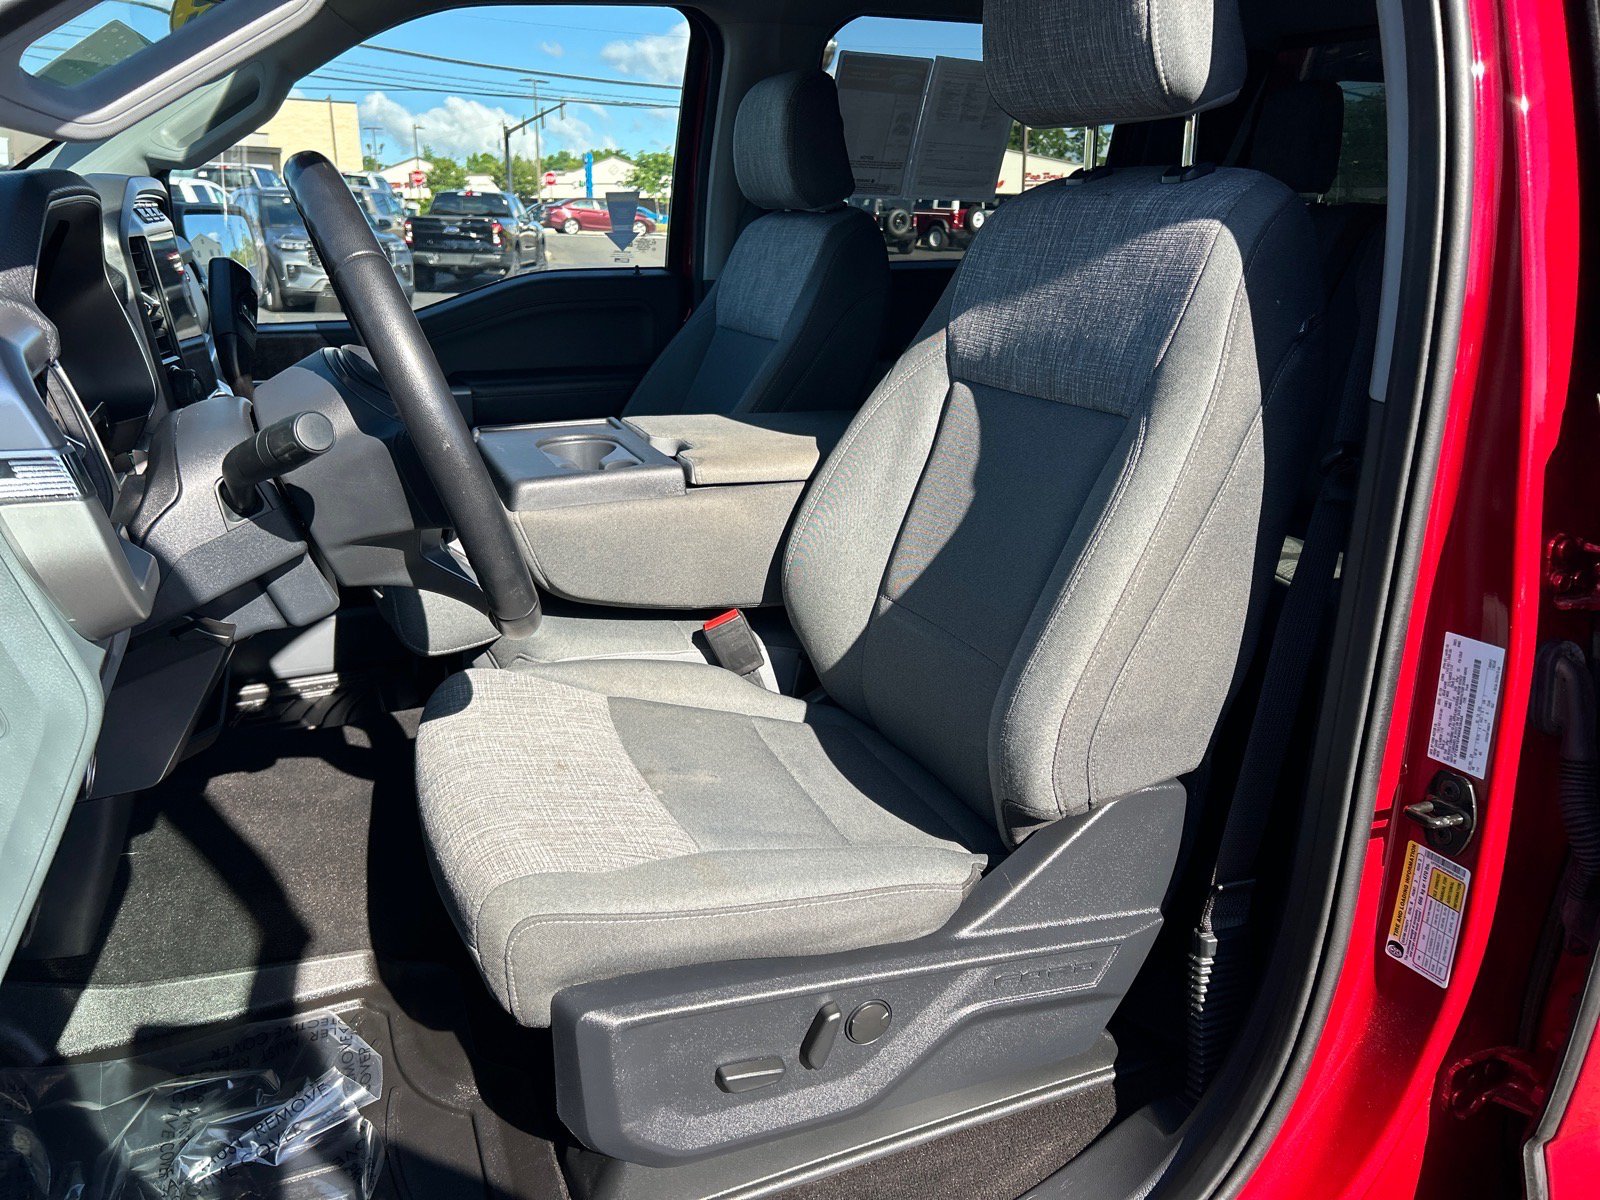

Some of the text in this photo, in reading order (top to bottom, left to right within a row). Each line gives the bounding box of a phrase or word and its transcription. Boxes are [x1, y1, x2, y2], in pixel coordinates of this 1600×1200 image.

[1399, 885, 1409, 911] LOADING
[1405, 843, 1417, 885] INFORMATION
[252, 1083, 332, 1138] REMOVE
